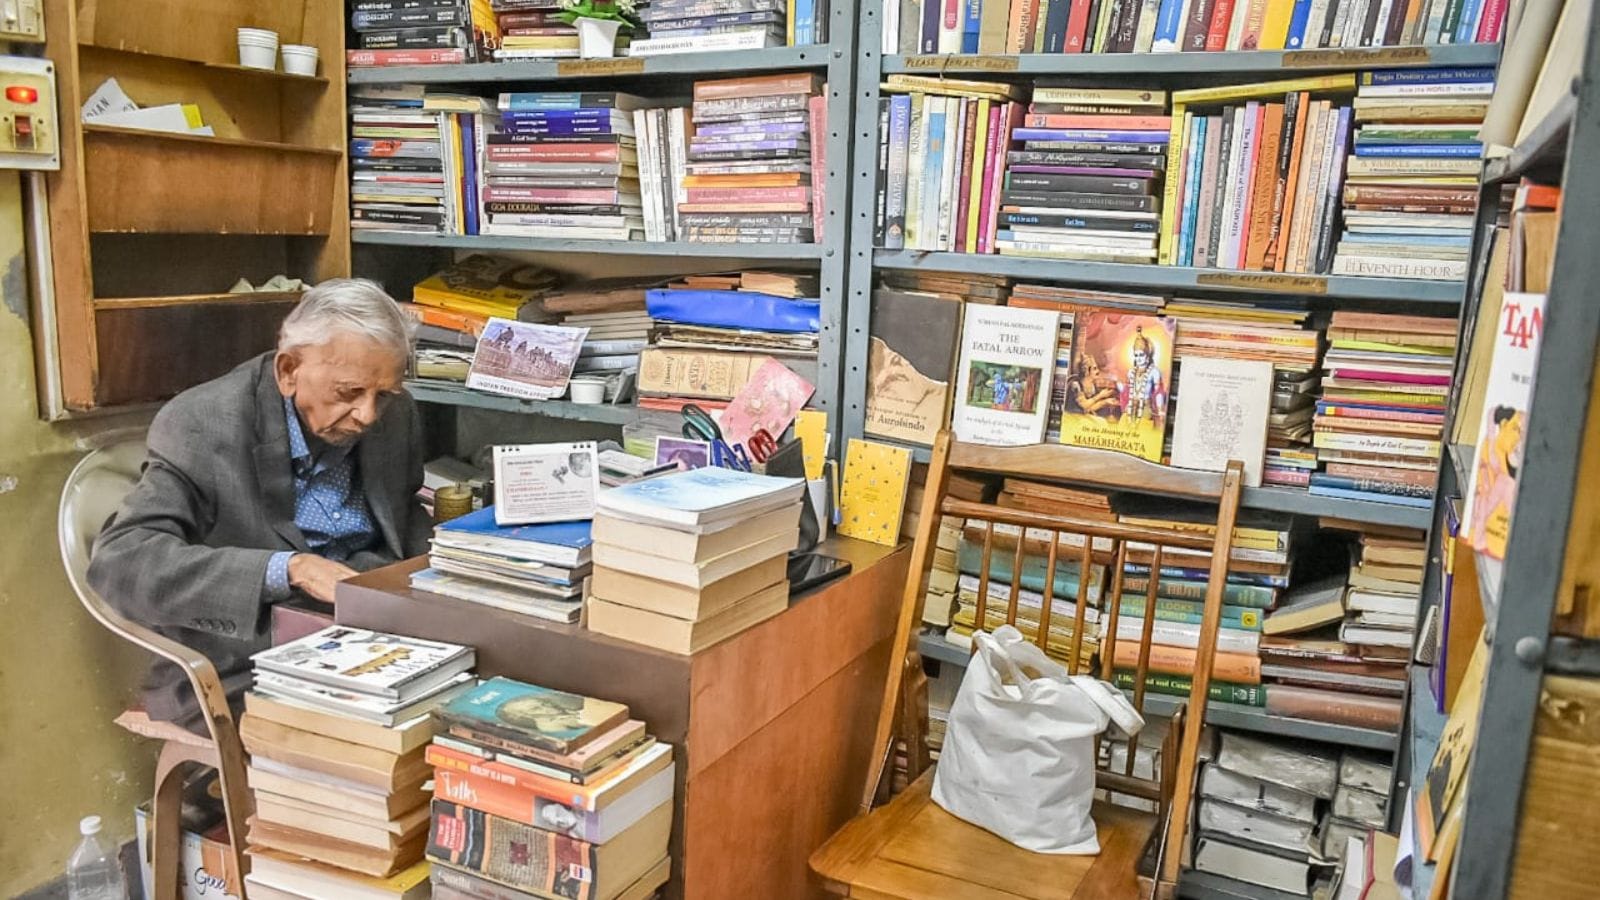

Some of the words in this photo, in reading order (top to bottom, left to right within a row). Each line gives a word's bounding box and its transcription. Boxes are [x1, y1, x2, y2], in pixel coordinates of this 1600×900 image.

[904, 57, 937, 68] PLEASE
[1440, 71, 1453, 79] the
[1238, 142, 1249, 176] Philosophy
[1263, 131, 1279, 205] CONSCIOUSNESS
[1256, 207, 1269, 243] SPEAKS
[1345, 259, 1409, 275] ELEVENTH
[1414, 262, 1451, 277] HOUR
[999, 333, 1020, 344] THE
[972, 341, 1001, 353] FATAL
[1005, 345, 1044, 357] ARROW
[877, 413, 926, 431] Aurobindo
[1156, 610, 1187, 620] ORLD
[1156, 679, 1170, 688] and
